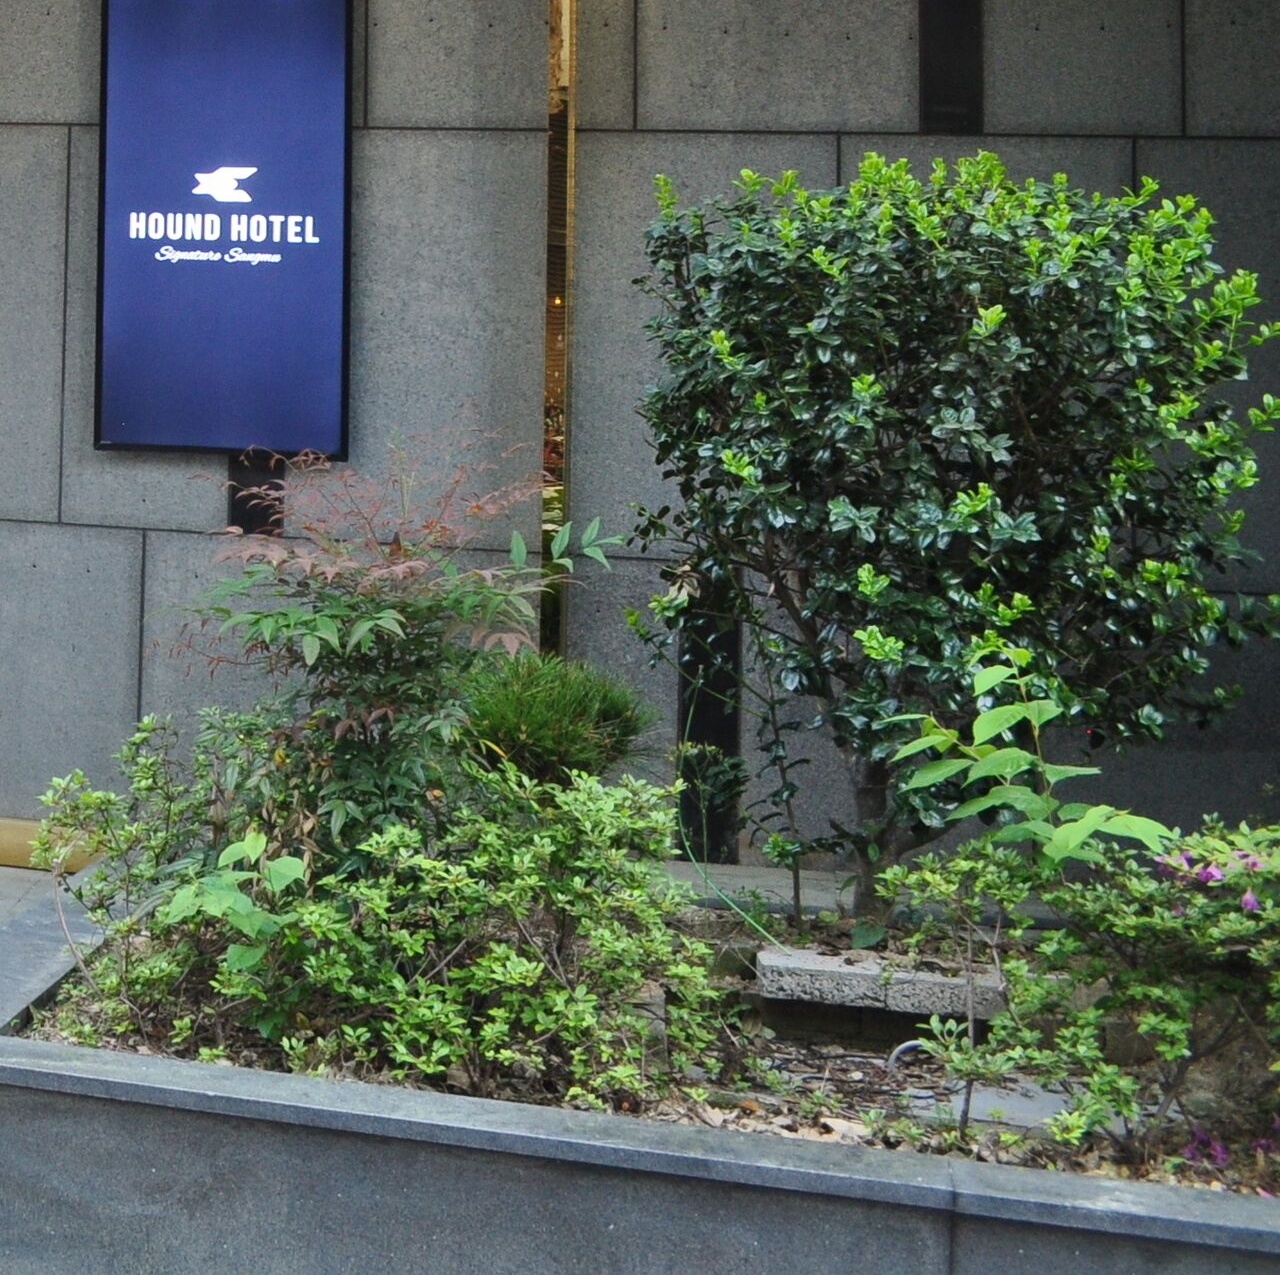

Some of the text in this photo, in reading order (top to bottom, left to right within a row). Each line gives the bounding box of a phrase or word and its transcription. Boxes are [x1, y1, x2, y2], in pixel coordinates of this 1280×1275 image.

[128, 211, 320, 244] HOUND HOTEL
[154, 245, 282, 266] Signature Sangmu
